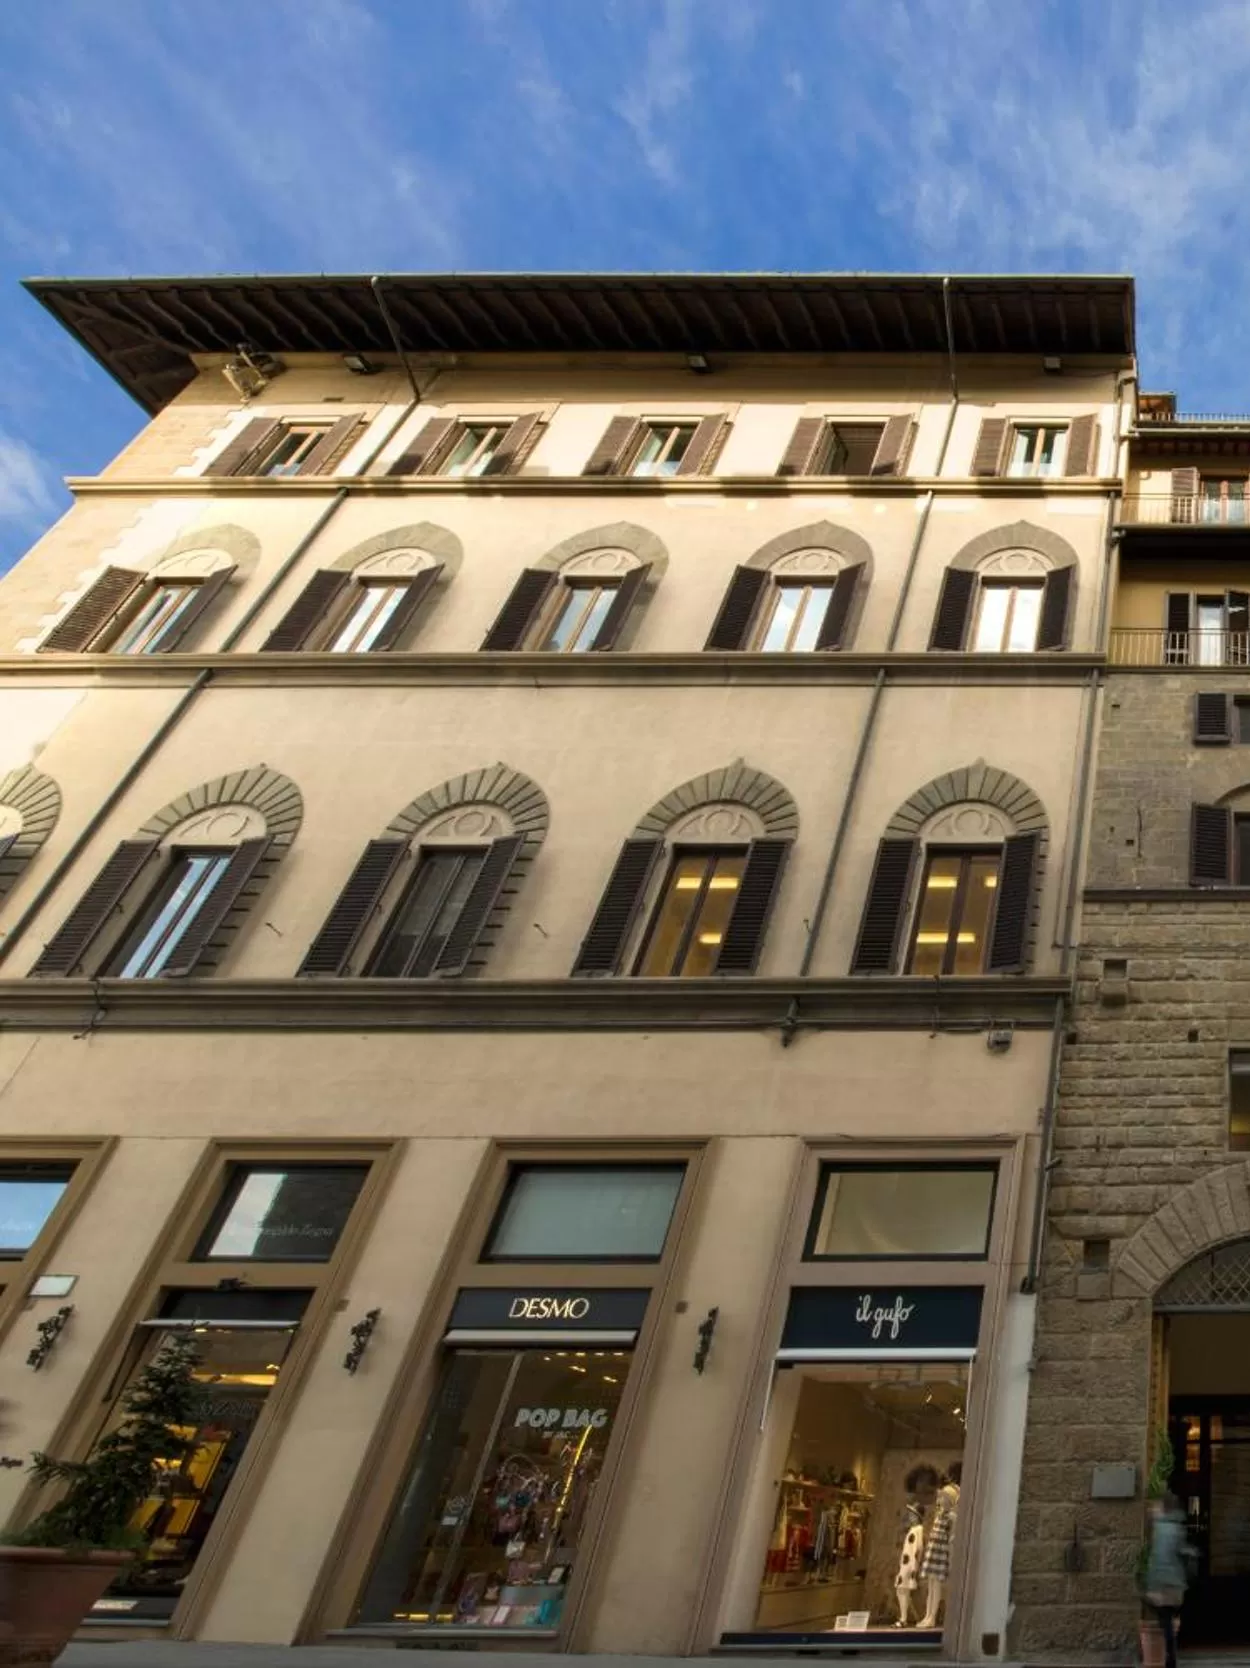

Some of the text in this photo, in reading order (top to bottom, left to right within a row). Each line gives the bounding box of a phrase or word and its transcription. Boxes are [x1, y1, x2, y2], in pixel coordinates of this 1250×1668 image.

[508, 1297, 590, 1319] DESMO
[856, 1294, 916, 1339] il gufo
[514, 1408, 608, 1428] POP BAG
